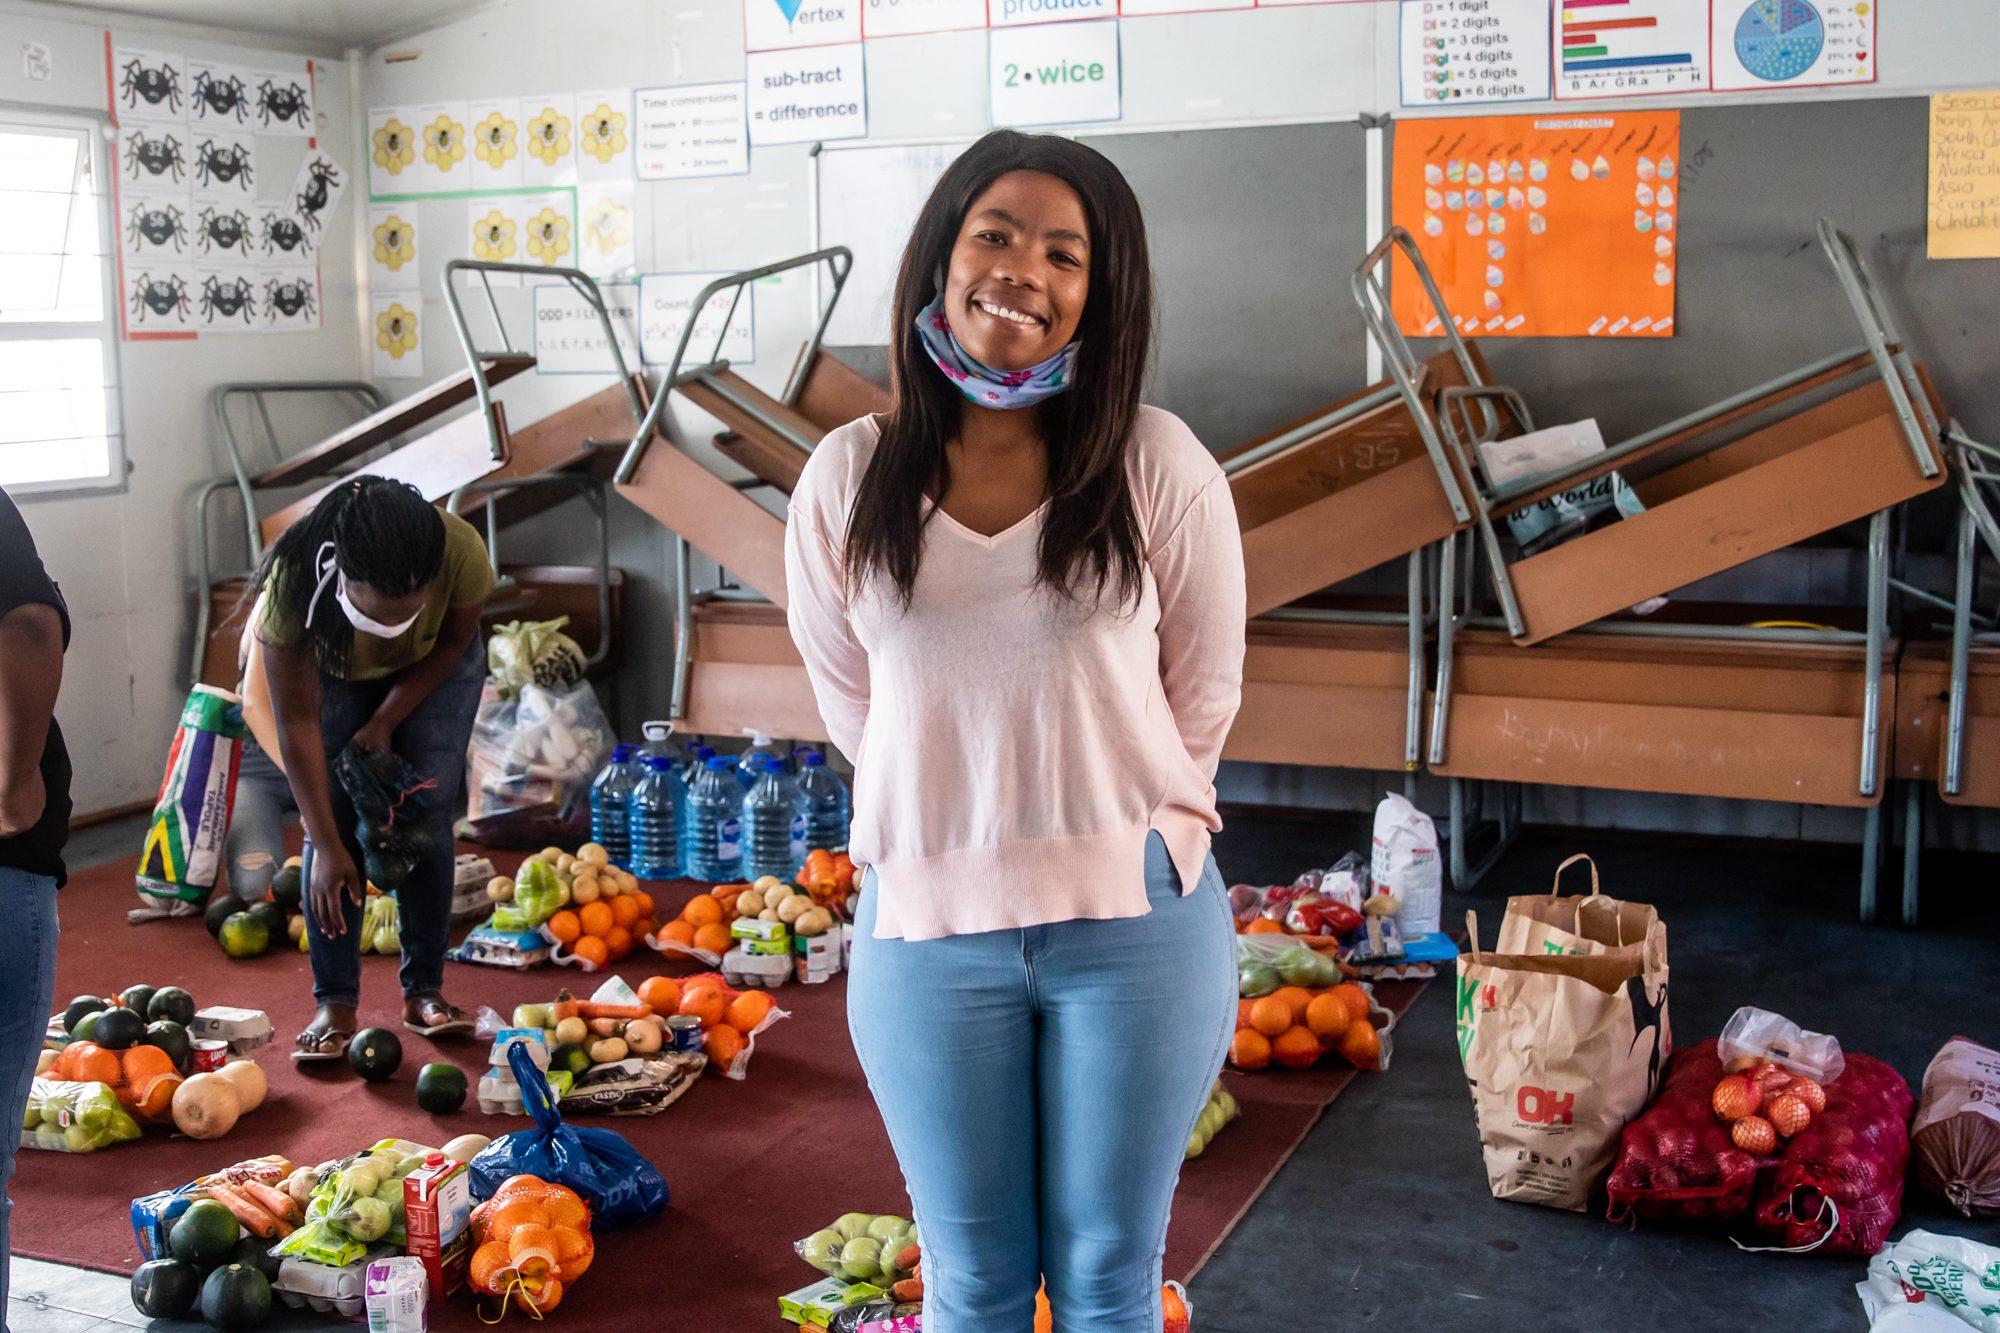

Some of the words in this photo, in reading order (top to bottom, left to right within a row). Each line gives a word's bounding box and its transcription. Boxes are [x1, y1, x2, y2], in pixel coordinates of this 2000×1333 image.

[1459, 0, 1488, 12] digit
[1452, 18, 1458, 28] 2
[1463, 16, 1499, 30] digits
[1460, 35, 1467, 45] 3
[1471, 33, 1508, 46] digits
[1464, 52, 1471, 61] 4
[1475, 50, 1512, 64] digits
[763, 67, 842, 88] sub-tract
[1469, 68, 1476, 79] 5
[1480, 67, 1517, 81] digits
[1476, 85, 1484, 96] 6
[1488, 85, 1525, 98] digits
[769, 102, 858, 122] difference
[201, 790, 217, 832] TAPOLE
[1517, 1086, 1574, 1125] OK
